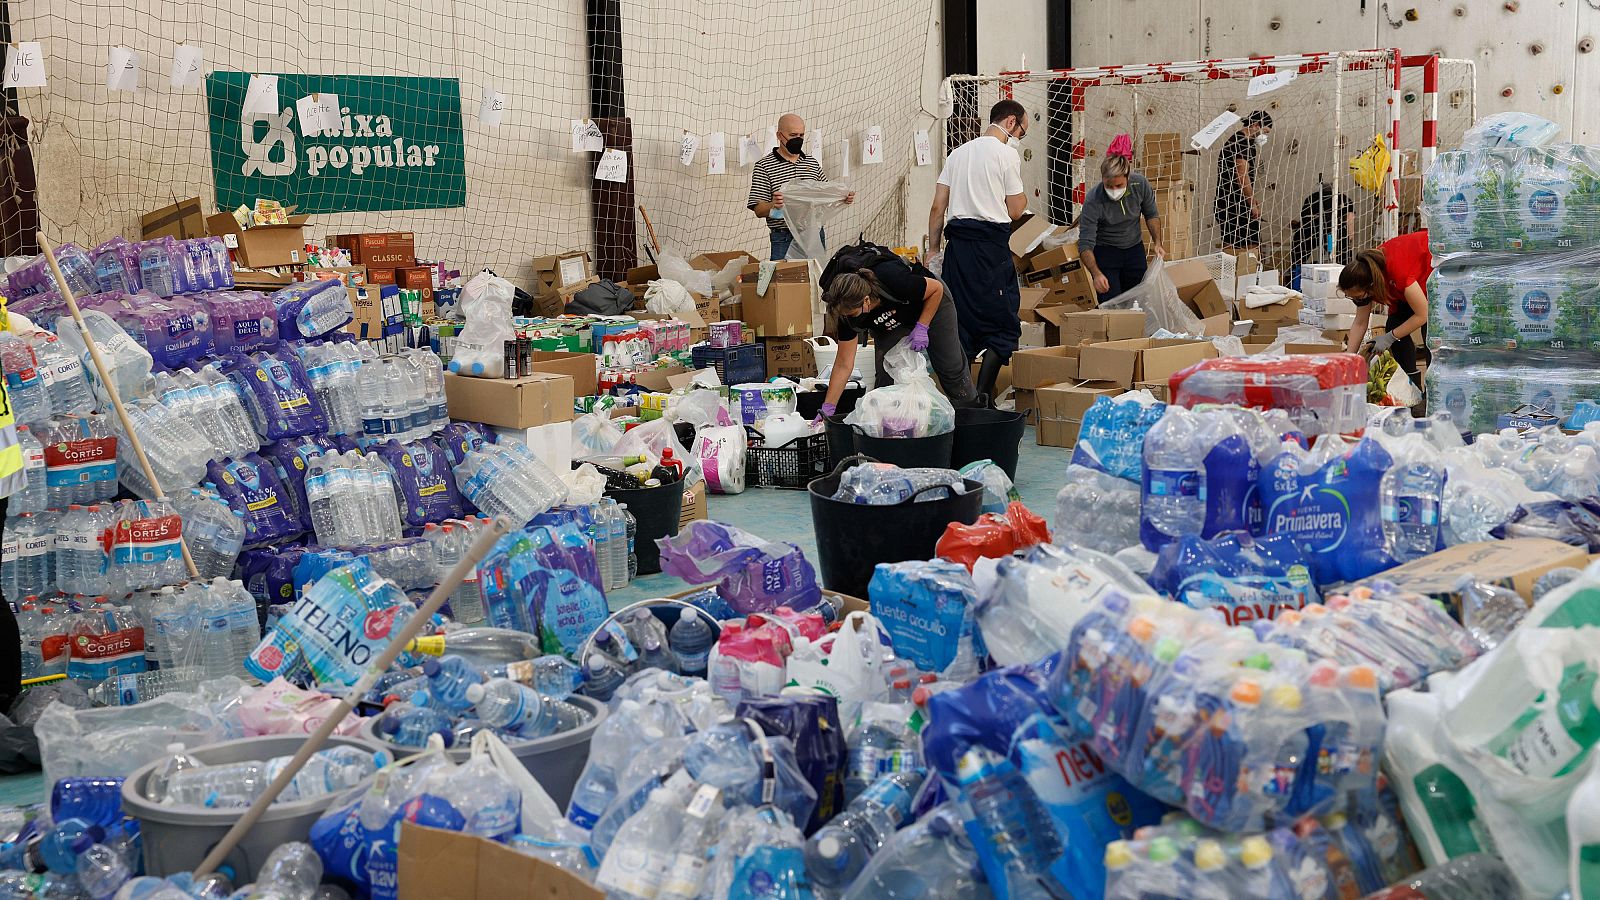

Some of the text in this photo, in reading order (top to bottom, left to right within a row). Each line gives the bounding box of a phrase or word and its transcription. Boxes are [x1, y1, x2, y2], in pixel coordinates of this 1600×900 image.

[305, 137, 439, 176] popular
[372, 254, 403, 262] CLASSIC
[169, 317, 192, 326] AQUA
[57, 360, 80, 375] CORTES
[1089, 423, 1133, 442] fuente
[65, 446, 103, 459] CORTES
[1275, 512, 1342, 532] Primavera
[130, 525, 168, 538] ORTES
[25, 540, 47, 550] CORTES
[1261, 591, 1295, 603] Segura
[875, 600, 907, 622] fuente
[294, 597, 372, 666] TELENO
[87, 638, 131, 653] CORTES
